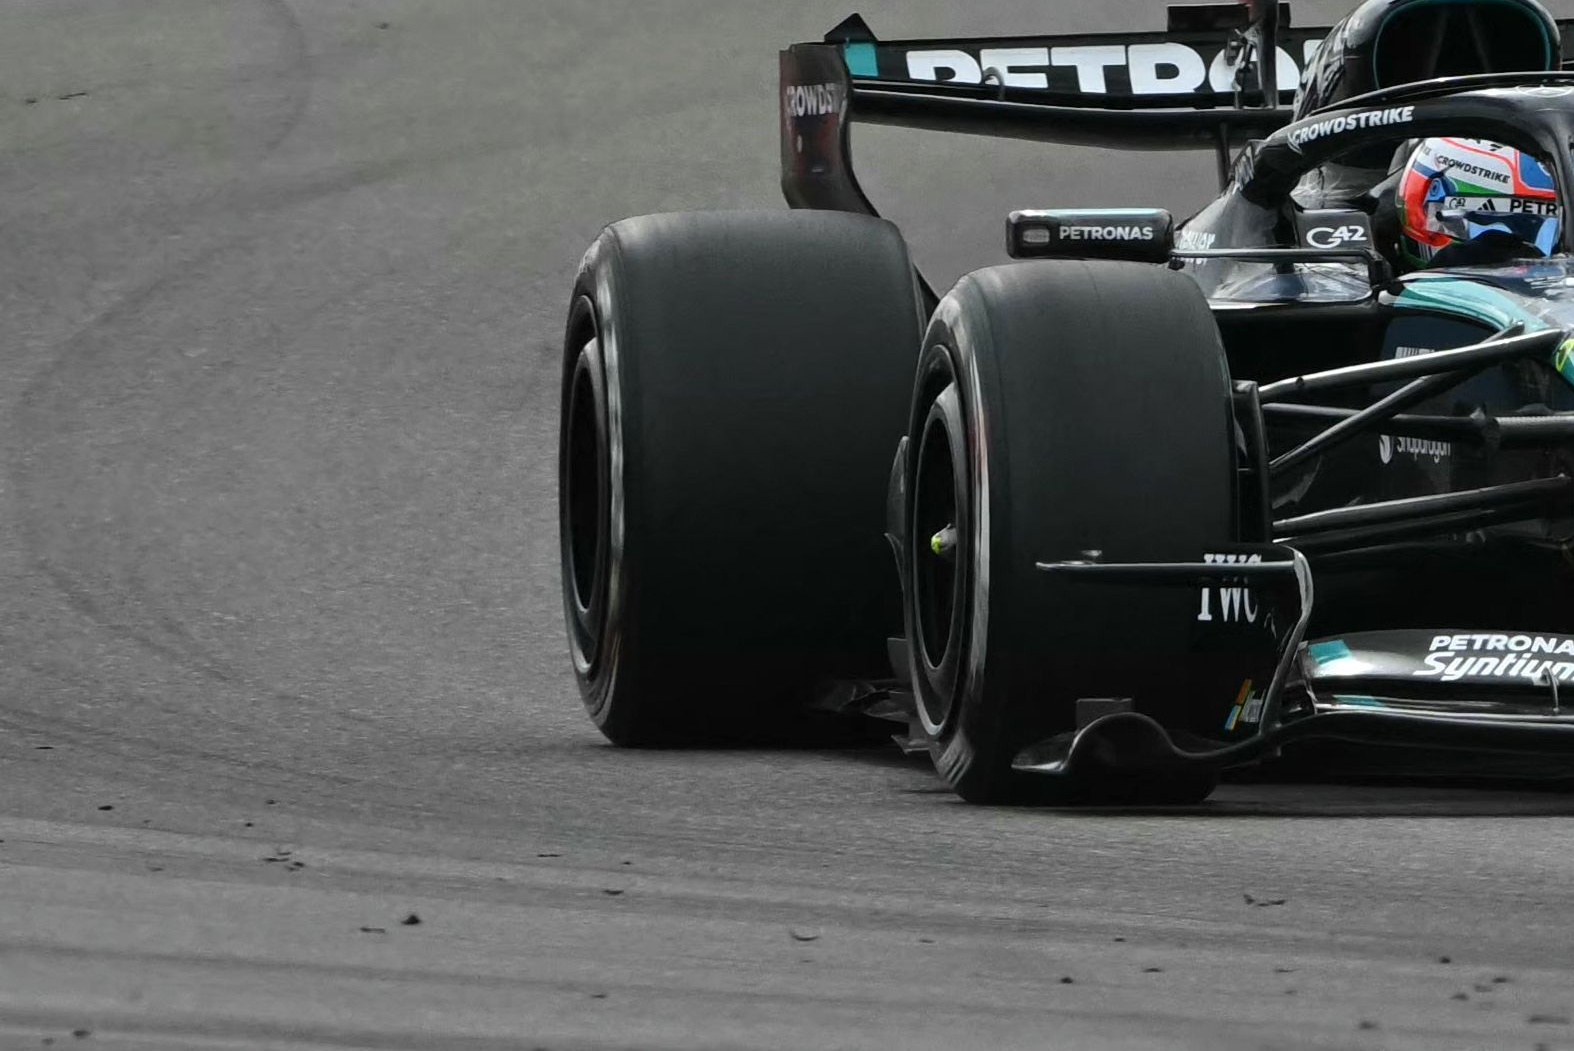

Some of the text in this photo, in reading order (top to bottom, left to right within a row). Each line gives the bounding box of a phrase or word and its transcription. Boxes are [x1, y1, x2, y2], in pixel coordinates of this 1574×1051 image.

[906, 41, 1322, 94] PETRO
[1292, 106, 1415, 146] CROWDSTRIKE
[1437, 154, 1510, 184] CROWDSTRIKE
[1058, 226, 1154, 241] PETRONAS
[1306, 225, 1368, 249] G42
